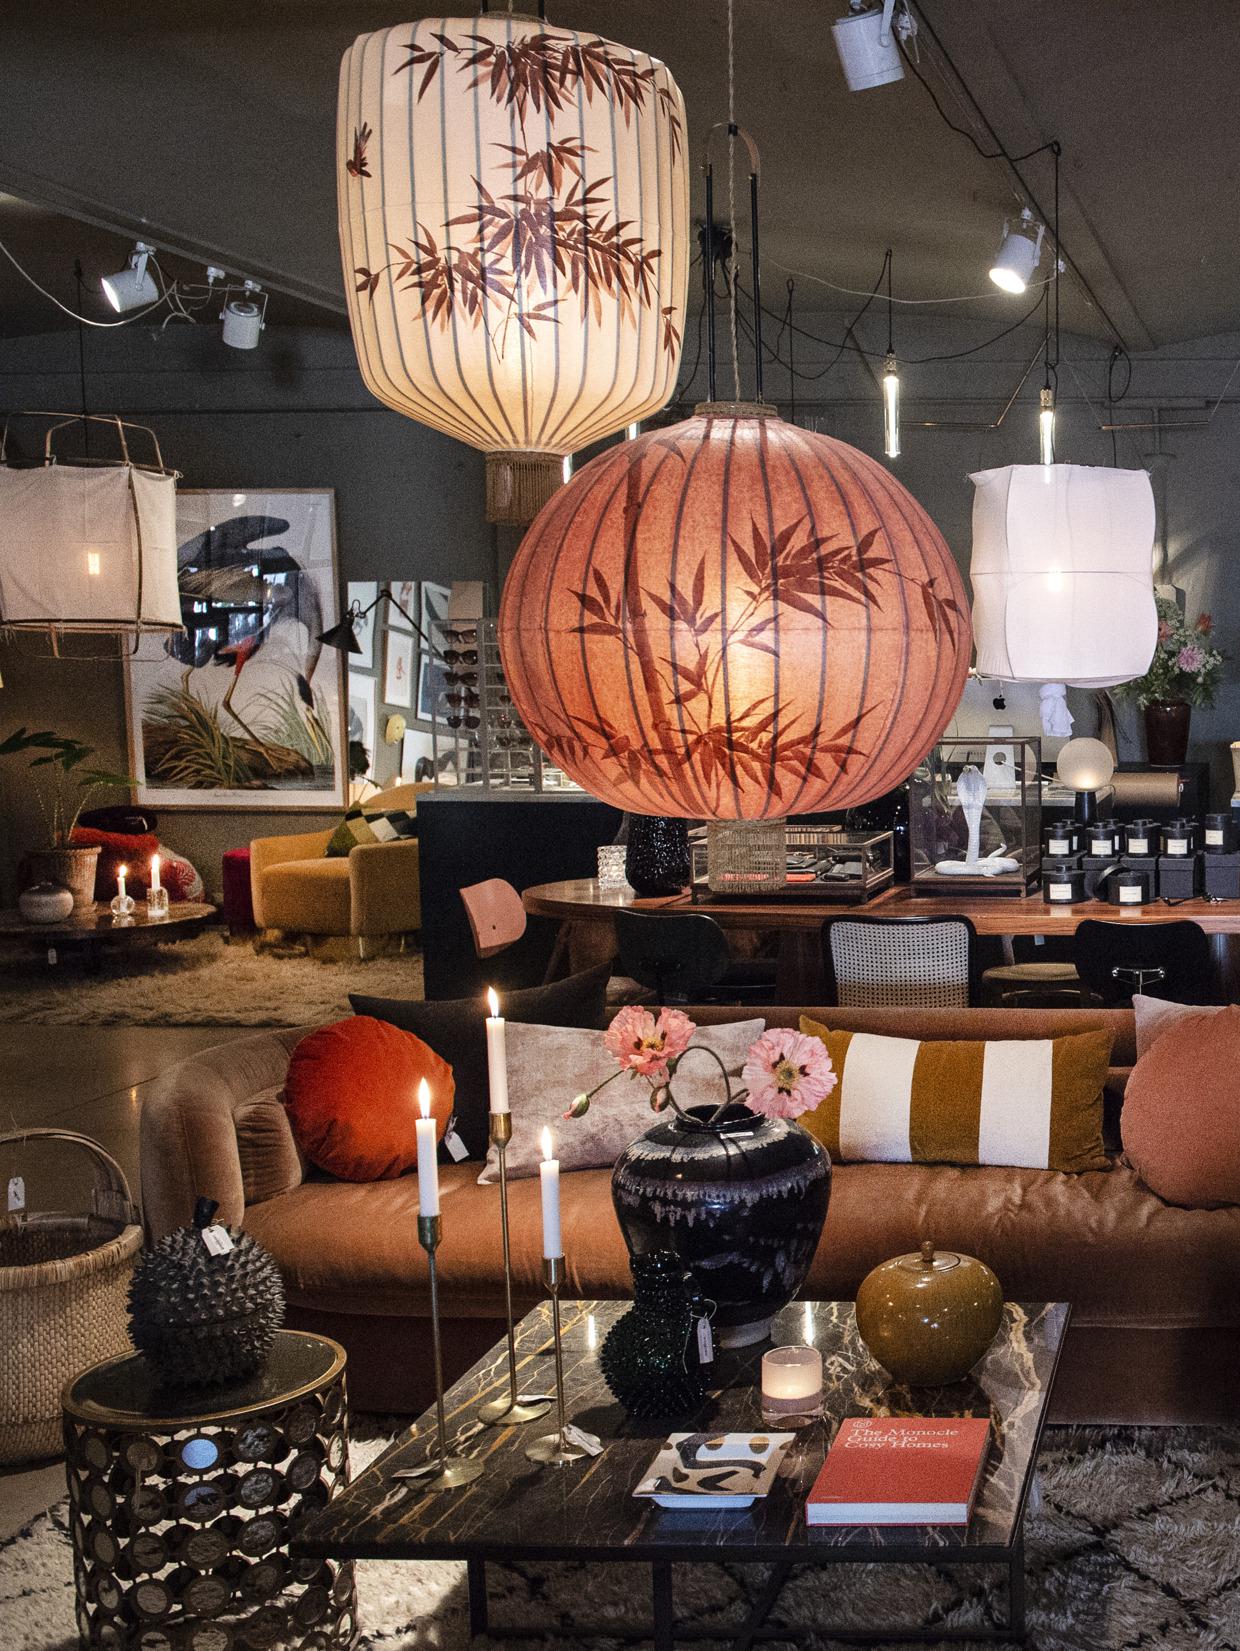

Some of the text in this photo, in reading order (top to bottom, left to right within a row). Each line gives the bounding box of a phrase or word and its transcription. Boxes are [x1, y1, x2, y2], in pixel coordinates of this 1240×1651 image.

[851, 1428, 959, 1436] The Monocle
[844, 1441, 949, 1449] Cosy Homes
